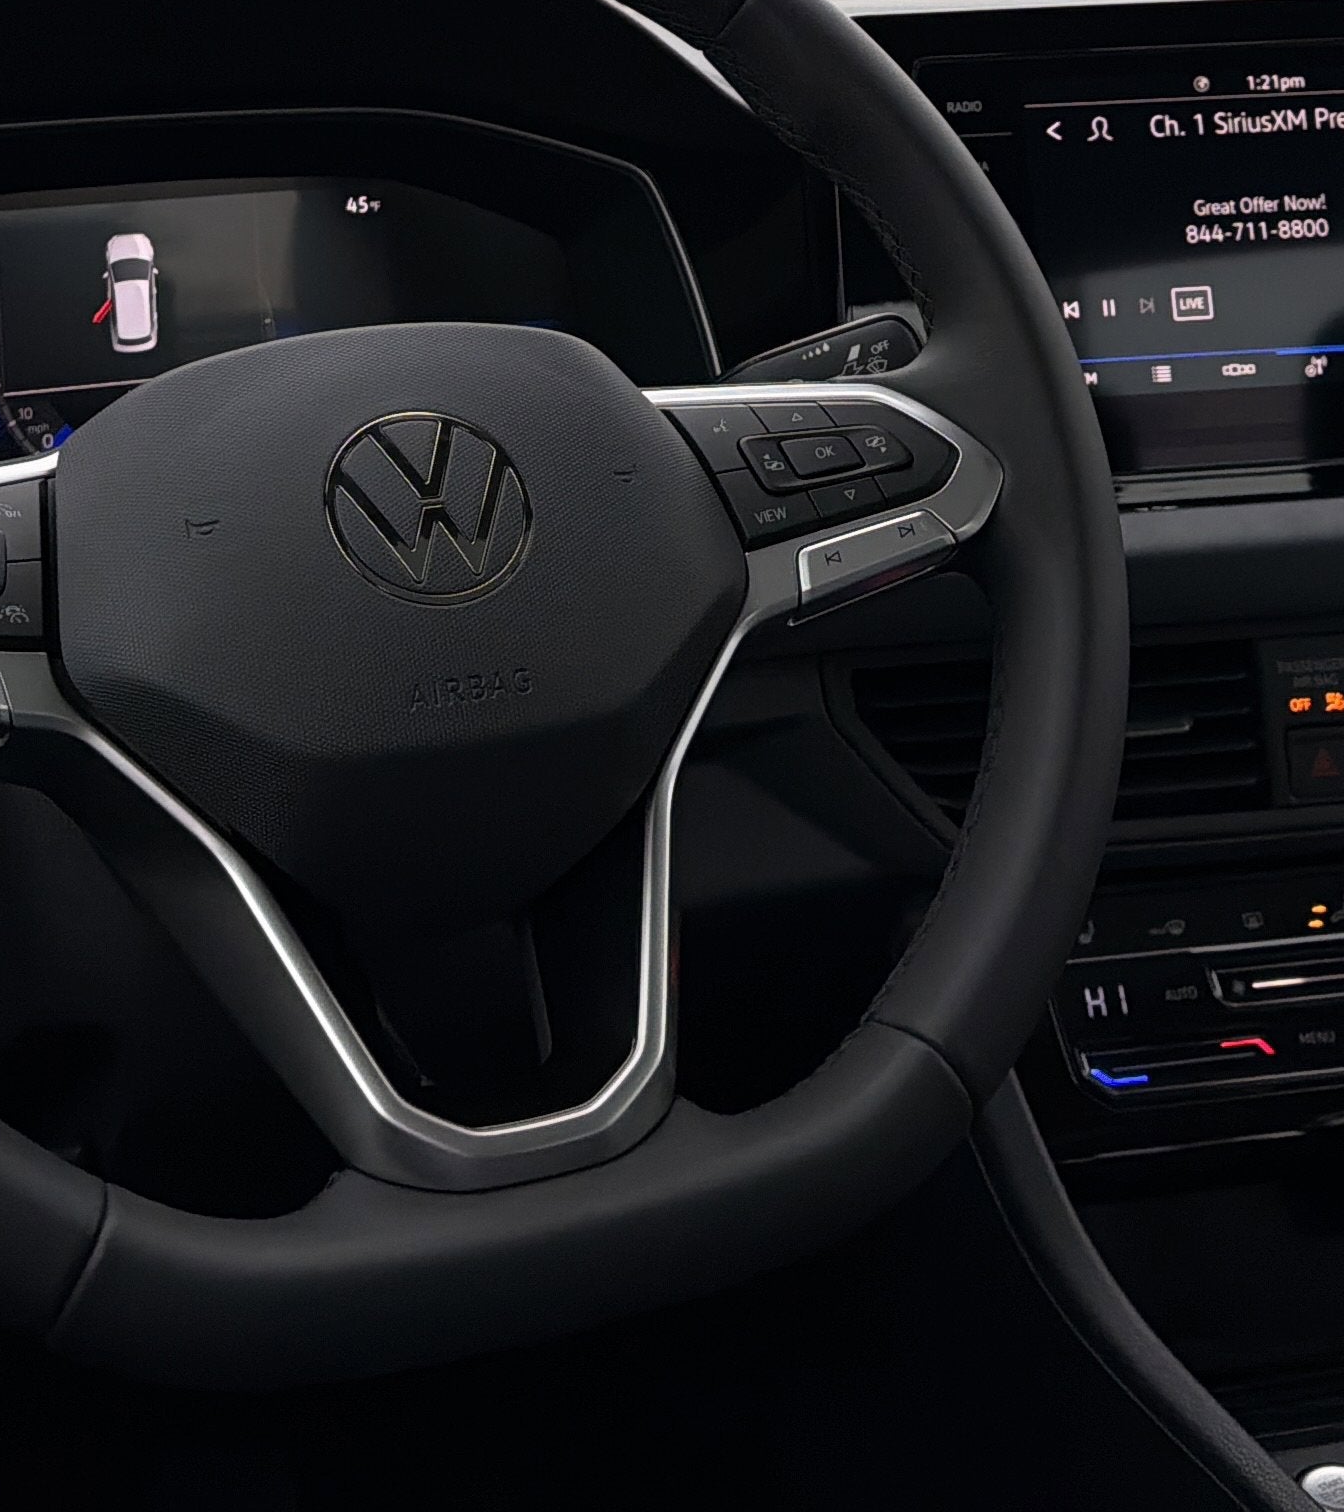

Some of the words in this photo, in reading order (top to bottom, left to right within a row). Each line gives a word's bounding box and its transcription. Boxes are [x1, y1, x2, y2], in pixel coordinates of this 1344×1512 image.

[1245, 74, 1306, 92] 1:21pm
[946, 100, 983, 115] RADIO
[1149, 114, 1187, 138] Ch.
[1193, 114, 1205, 136] 1
[1213, 108, 1308, 135] SiriusXM
[1193, 199, 1237, 217] Great
[1239, 196, 1280, 214] Offer
[1283, 193, 1328, 212] Now!
[1185, 218, 1330, 244] 844-711-8800
[1178, 296, 1205, 311] LIVE
[870, 339, 891, 356] OFF
[17, 406, 34, 421] 10
[27, 421, 50, 435] mph
[41, 432, 54, 449] 0
[814, 444, 835, 460] OK
[754, 506, 788, 525] VIEW
[408, 667, 535, 714] AIRBAG
[1289, 696, 1312, 713] OFF
[1083, 983, 1130, 1018] HI
